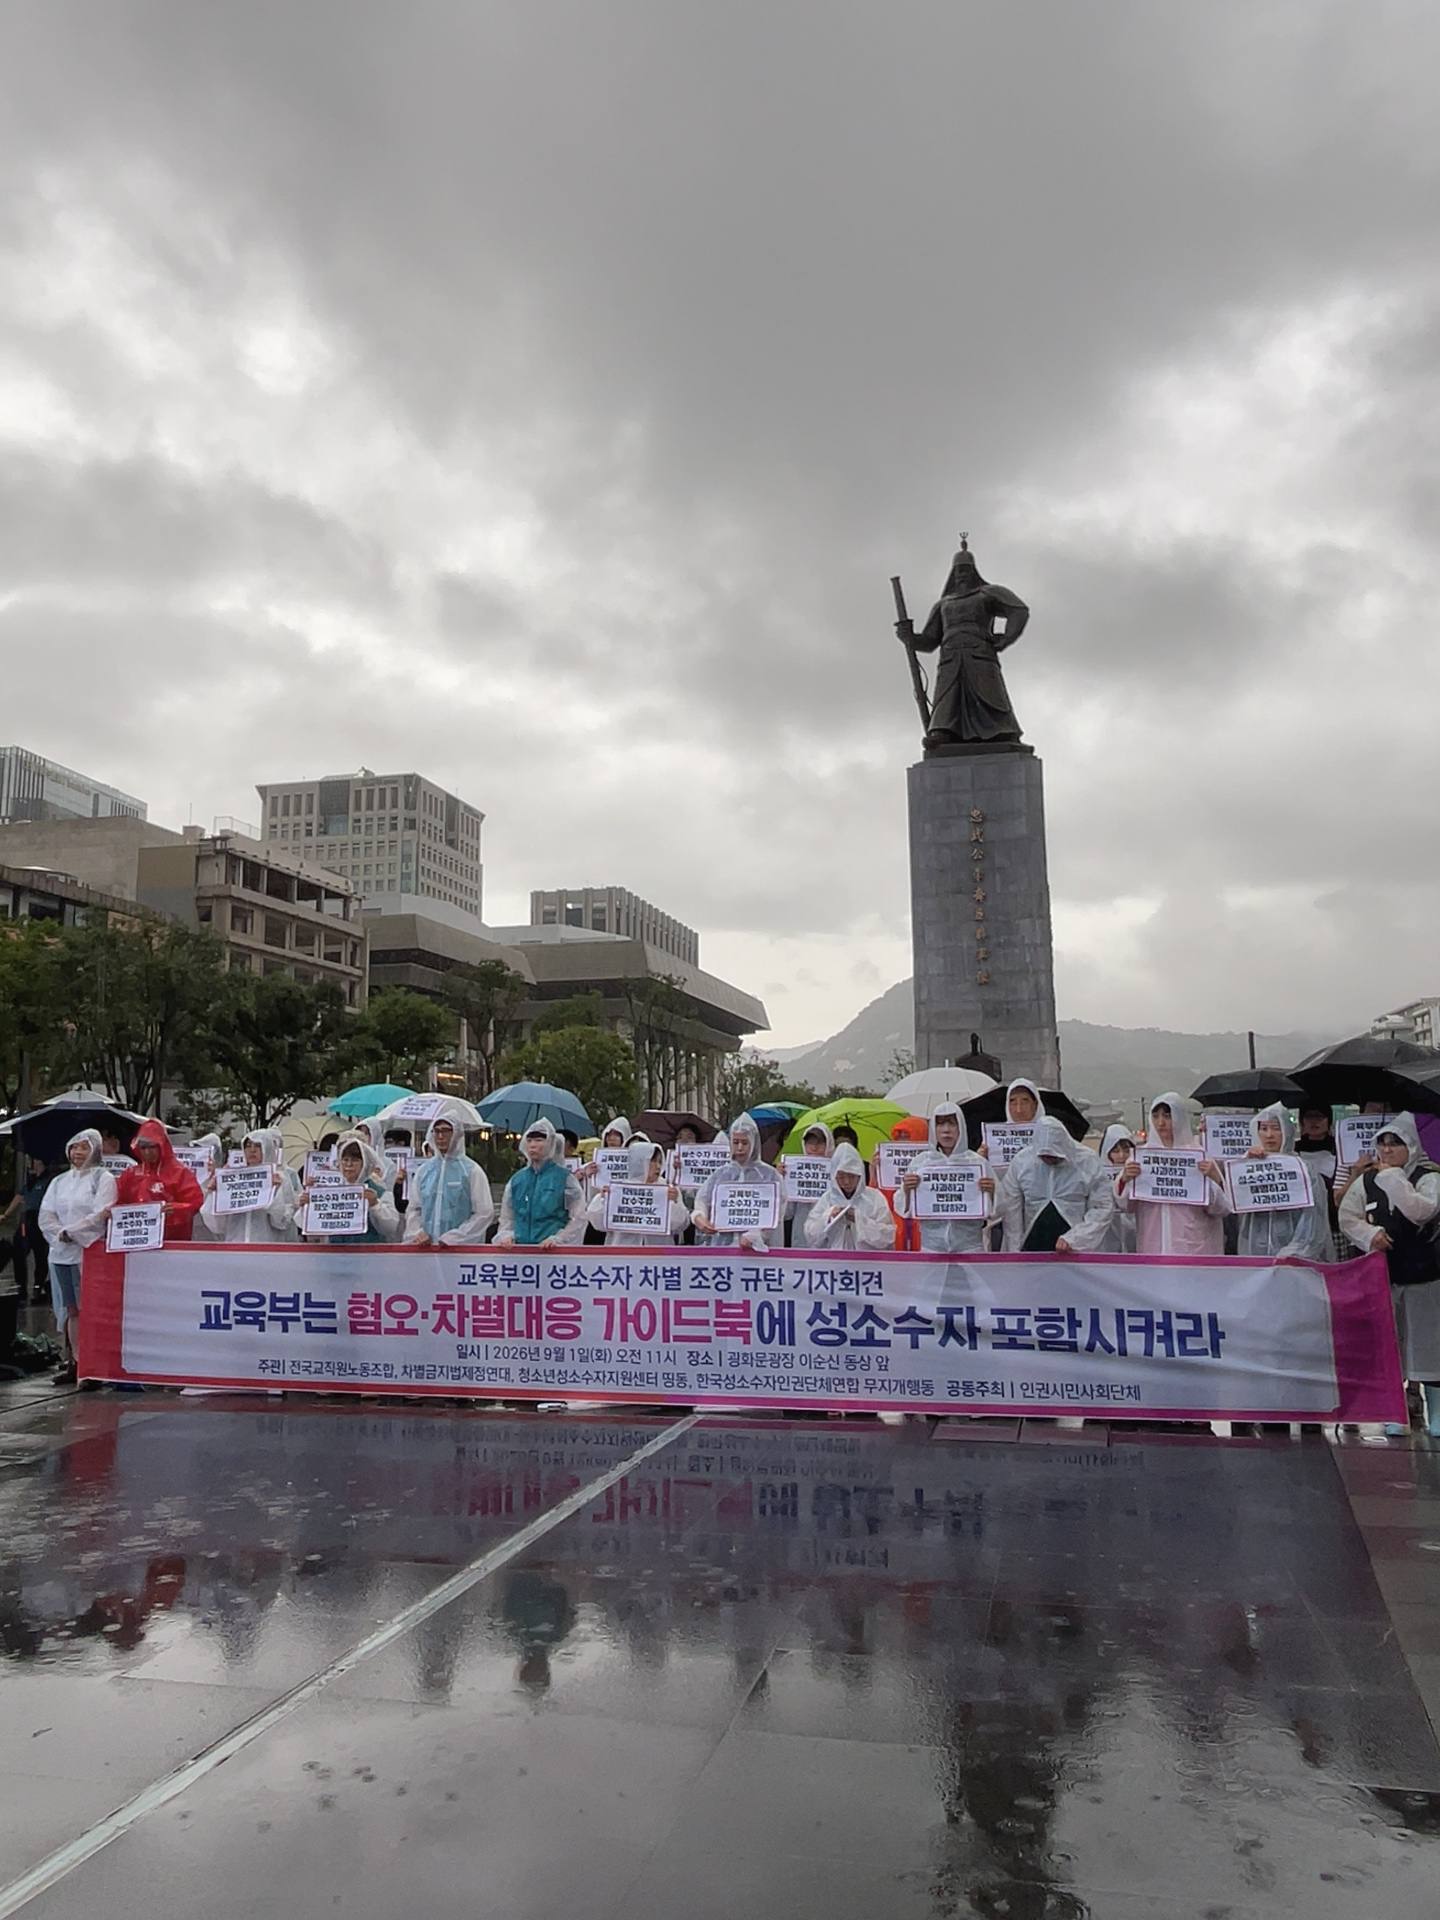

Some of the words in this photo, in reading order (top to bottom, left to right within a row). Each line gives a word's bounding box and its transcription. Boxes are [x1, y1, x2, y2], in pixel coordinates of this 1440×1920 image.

[601, 1155, 628, 1163] 교육부장
[1142, 1156, 1196, 1168] 교육부장관은
[1150, 1166, 1186, 1178] 사과하고
[1246, 1162, 1284, 1174] 교육부는
[922, 1172, 975, 1182] 교육부장관은
[1238, 1174, 1276, 1185] 성소수자
[1278, 1170, 1298, 1181] 차별
[930, 1183, 965, 1192] 사과하고
[1250, 1183, 1288, 1194] 해명하고
[728, 1190, 760, 1199] 교육부는
[936, 1193, 962, 1202] 면담에
[1252, 1194, 1290, 1205] 사과하라
[720, 1198, 752, 1208] 성소수자
[753, 1199, 770, 1208] 차별
[728, 1208, 760, 1218] 해명하고
[932, 1204, 968, 1214] 응답하라
[728, 1217, 759, 1226] 사과하라
[458, 1263, 540, 1288] 교육부의
[547, 1264, 633, 1290] 성소수자
[639, 1266, 682, 1292] 차별
[689, 1266, 734, 1292] 조장
[741, 1267, 785, 1292] 규탄
[793, 1269, 884, 1296] 기자회견
[199, 1290, 338, 1335] 교육부는
[347, 1293, 583, 1341] 혐오·차별대응
[592, 1298, 797, 1346] 가이드북에
[806, 1301, 982, 1351] 성소수자
[990, 1307, 1226, 1359] 포함시켜라
[456, 1344, 480, 1360] 일시
[493, 1346, 541, 1362] 2026년
[544, 1346, 566, 1362] 9월
[569, 1347, 612, 1364] 1일(화)
[616, 1348, 642, 1365] 오전
[646, 1350, 677, 1366] 11시
[686, 1350, 714, 1367] 장소
[728, 1351, 794, 1370] 광화문광장
[800, 1353, 840, 1370] 이순신
[844, 1354, 872, 1372] 동상
[874, 1355, 890, 1372] 앞
[290, 1360, 398, 1380] 전국교직원노동조합,
[401, 1363, 515, 1383] 차별금지법제정연대,
[518, 1366, 658, 1388] 청소년성소수자지원센터
[696, 1372, 860, 1394] 한국성소수자인권단체연합
[864, 1378, 935, 1398] 무지개행동
[946, 1380, 1004, 1398] 공동주최
[1020, 1382, 1140, 1401] 인권시민사회단체
